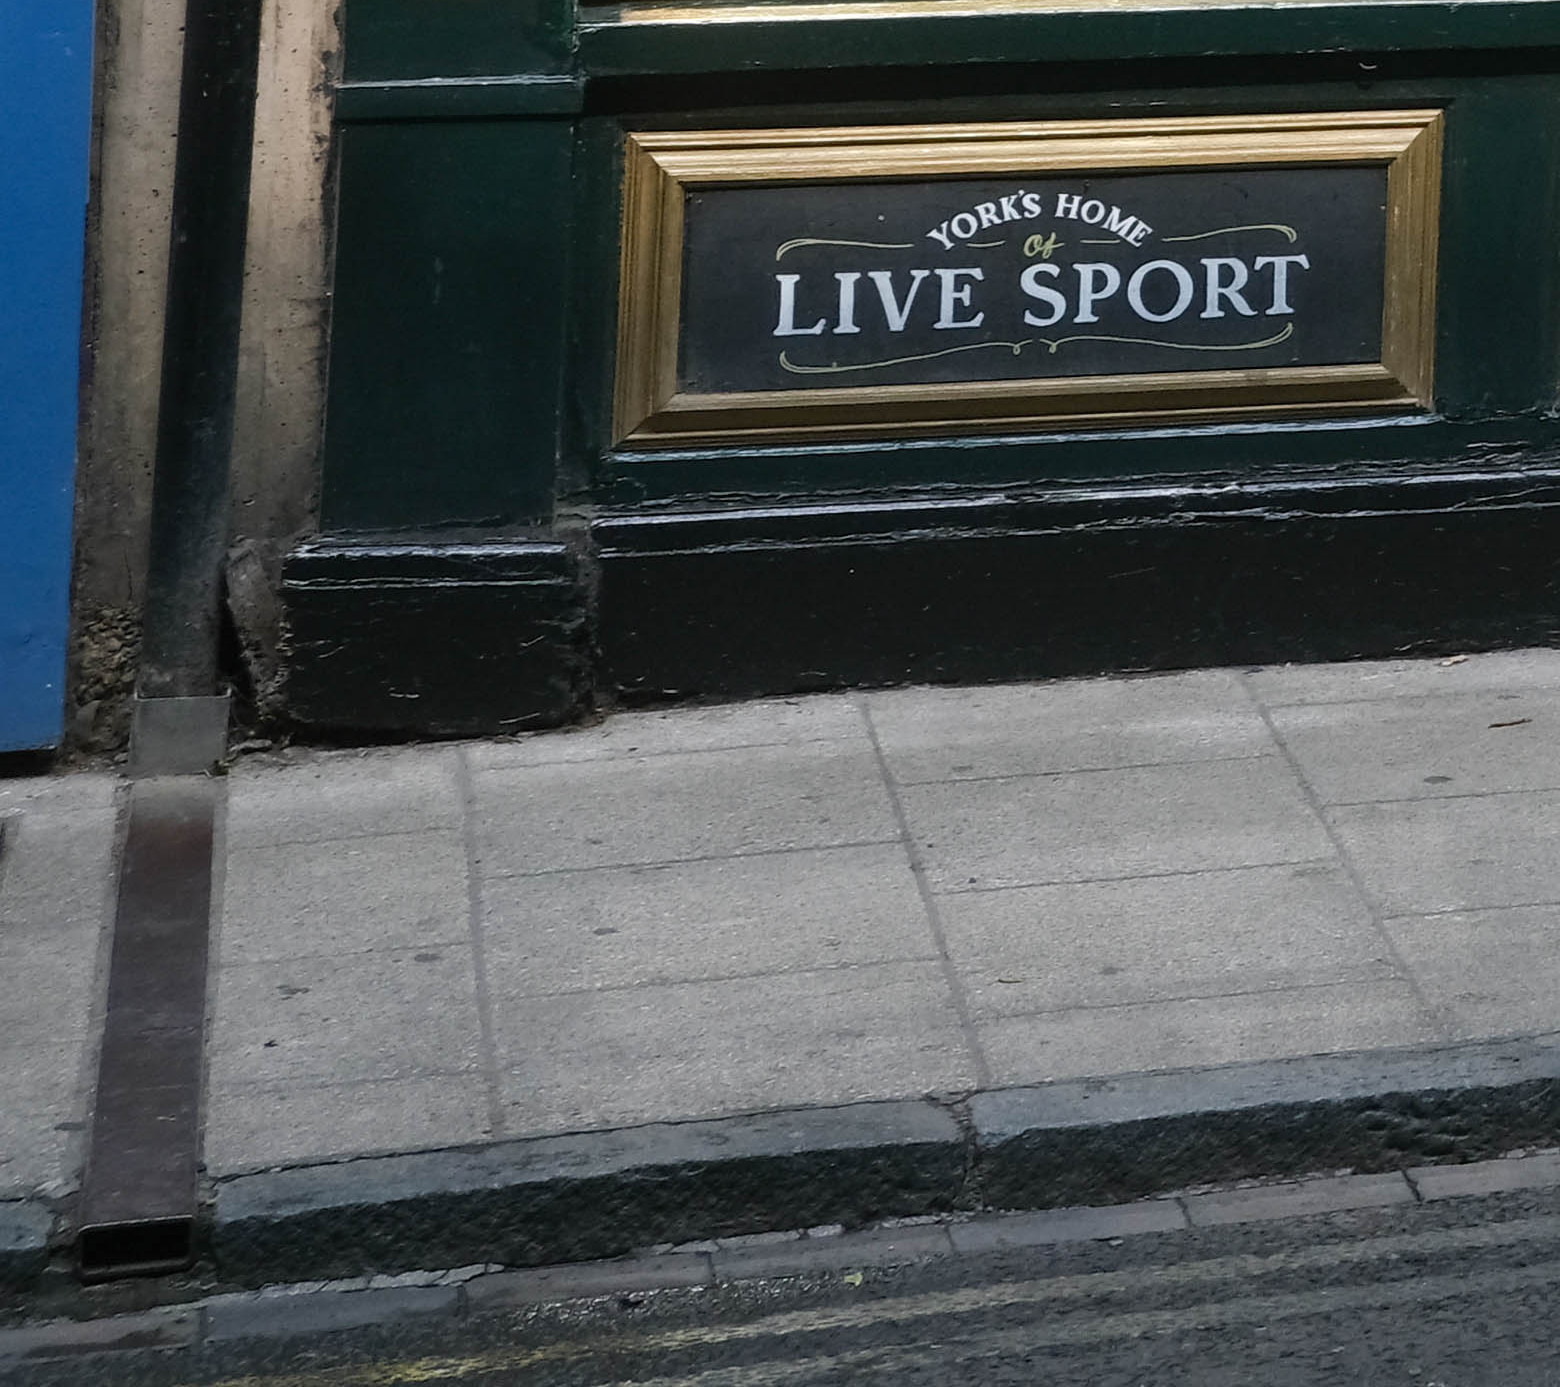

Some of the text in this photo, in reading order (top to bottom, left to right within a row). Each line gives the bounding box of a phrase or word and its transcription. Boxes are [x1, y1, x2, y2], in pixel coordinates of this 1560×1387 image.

[926, 188, 1154, 252] YORK'S HOME
[771, 253, 1311, 338] LIVE SPORT
